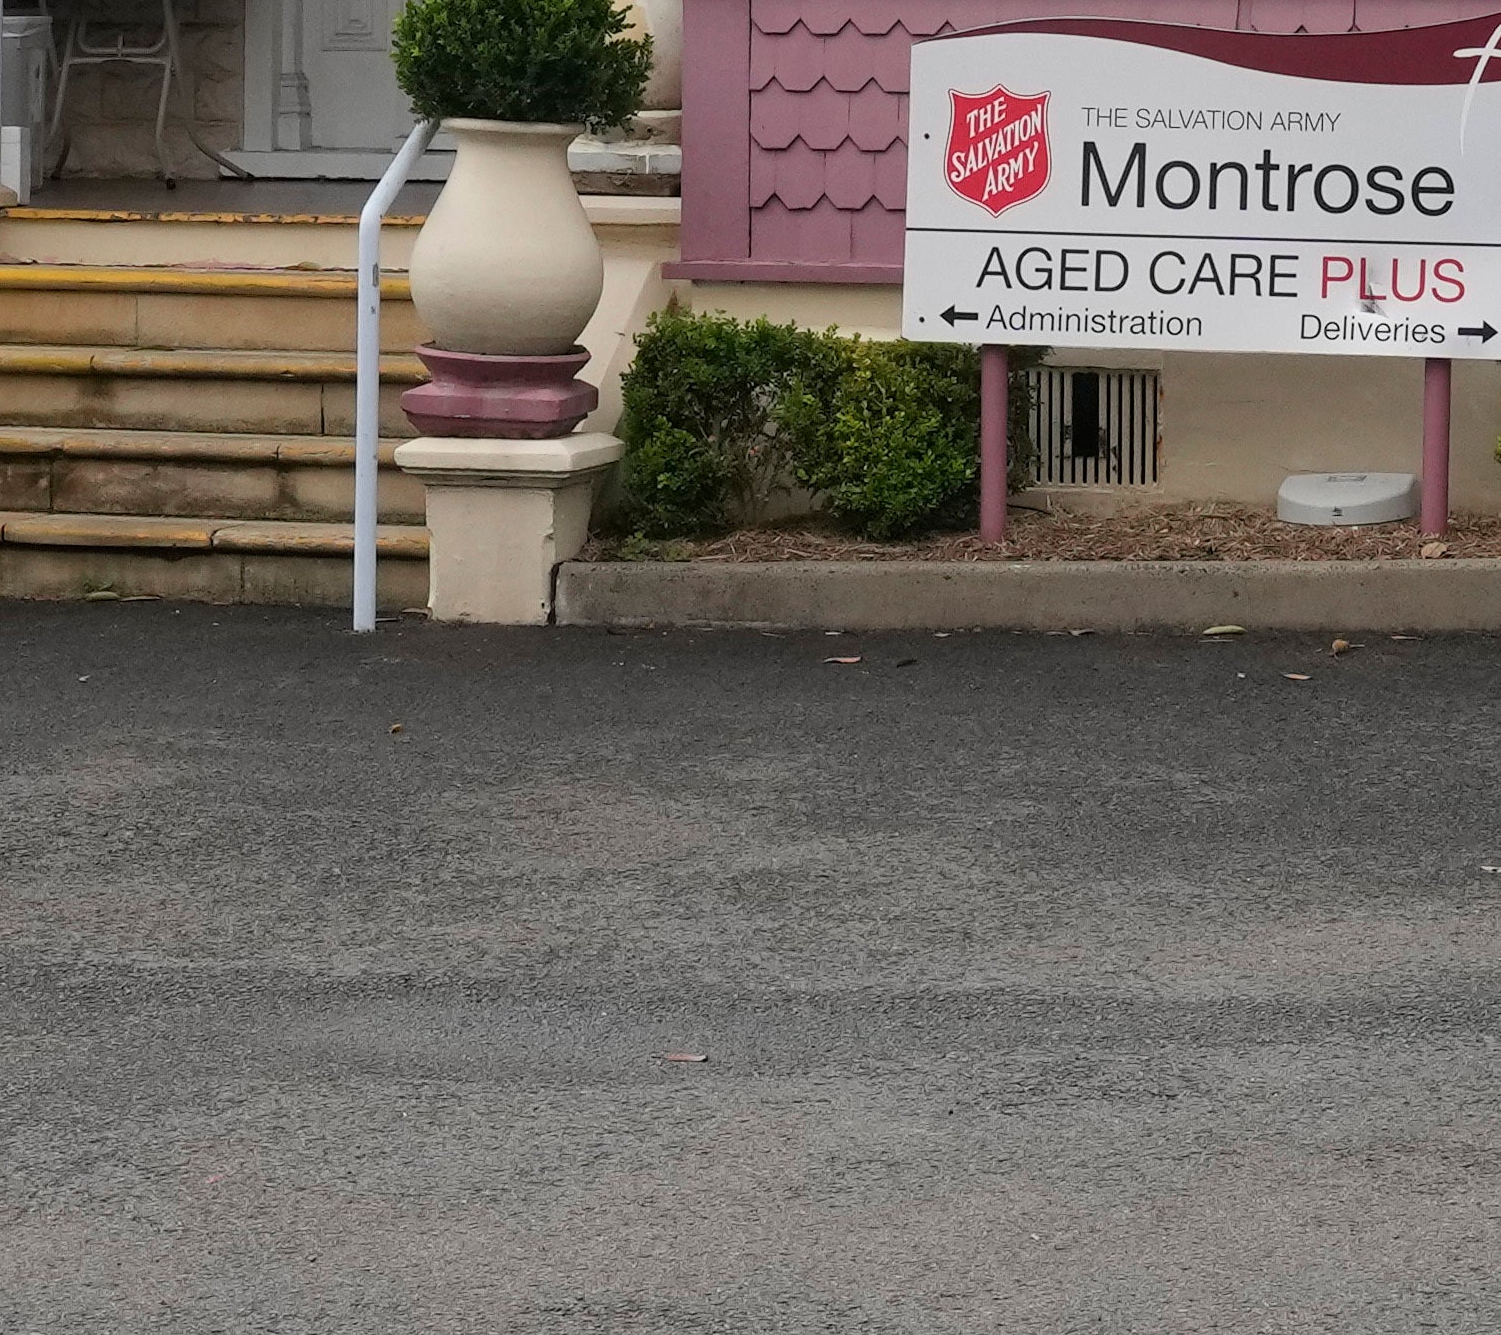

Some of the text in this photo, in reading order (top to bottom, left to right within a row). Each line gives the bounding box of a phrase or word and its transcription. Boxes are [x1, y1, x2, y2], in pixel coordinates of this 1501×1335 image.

[966, 96, 1007, 139] THE
[1081, 107, 1342, 132] THE SALVATION ARMY
[950, 103, 1042, 183] SALVATION
[981, 141, 1039, 203] ARMY
[1082, 141, 1455, 217] Montrose
[975, 246, 1466, 303] AGED CARE PLUS
[985, 304, 1203, 337] Administration
[1300, 314, 1446, 344] Deliveries
